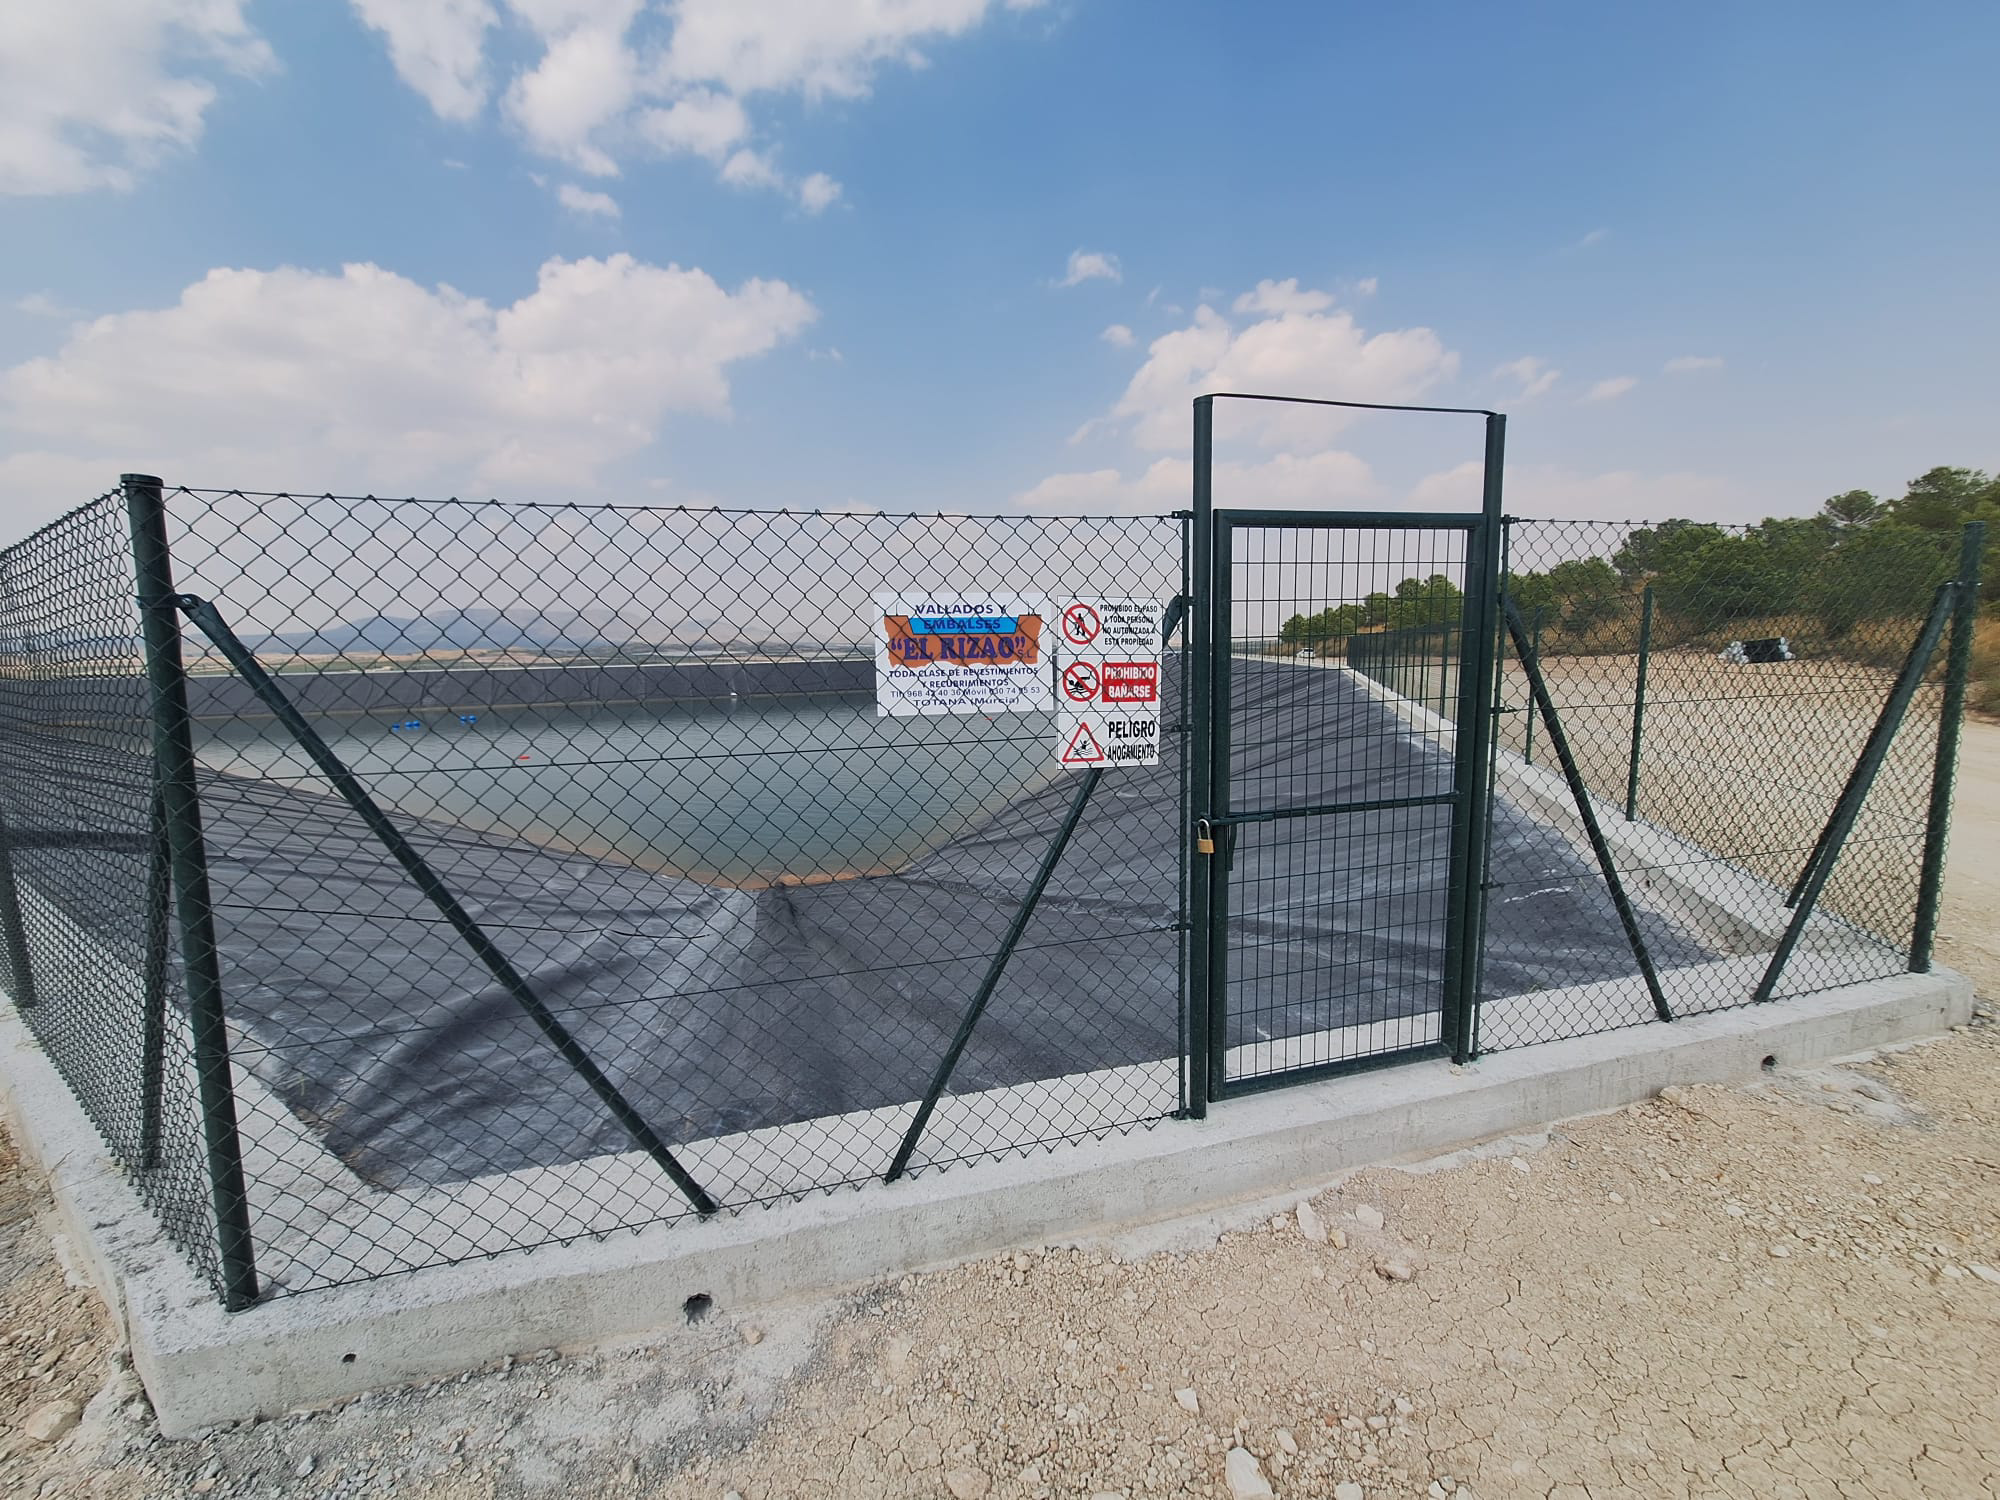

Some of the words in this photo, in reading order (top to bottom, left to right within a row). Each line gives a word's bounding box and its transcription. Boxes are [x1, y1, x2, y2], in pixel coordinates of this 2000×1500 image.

[916, 604, 993, 614] VALLADOS
[1134, 604, 1142, 612] EL
[924, 620, 1000, 629] EMBALSES
[1104, 638, 1119, 646] ESTA
[1121, 638, 1154, 646] PROPIEDAD
[964, 668, 1038, 676] REVESTIMIENTOS
[1104, 666, 1154, 680] PROHIBIDO
[930, 679, 1008, 688] RECUBRIMIENTOS
[1108, 682, 1150, 698] BAÑARSE
[914, 698, 966, 706] TOTANA
[1108, 720, 1155, 738] PELIGRO
[1108, 744, 1154, 760] AHOGAMIENTO
